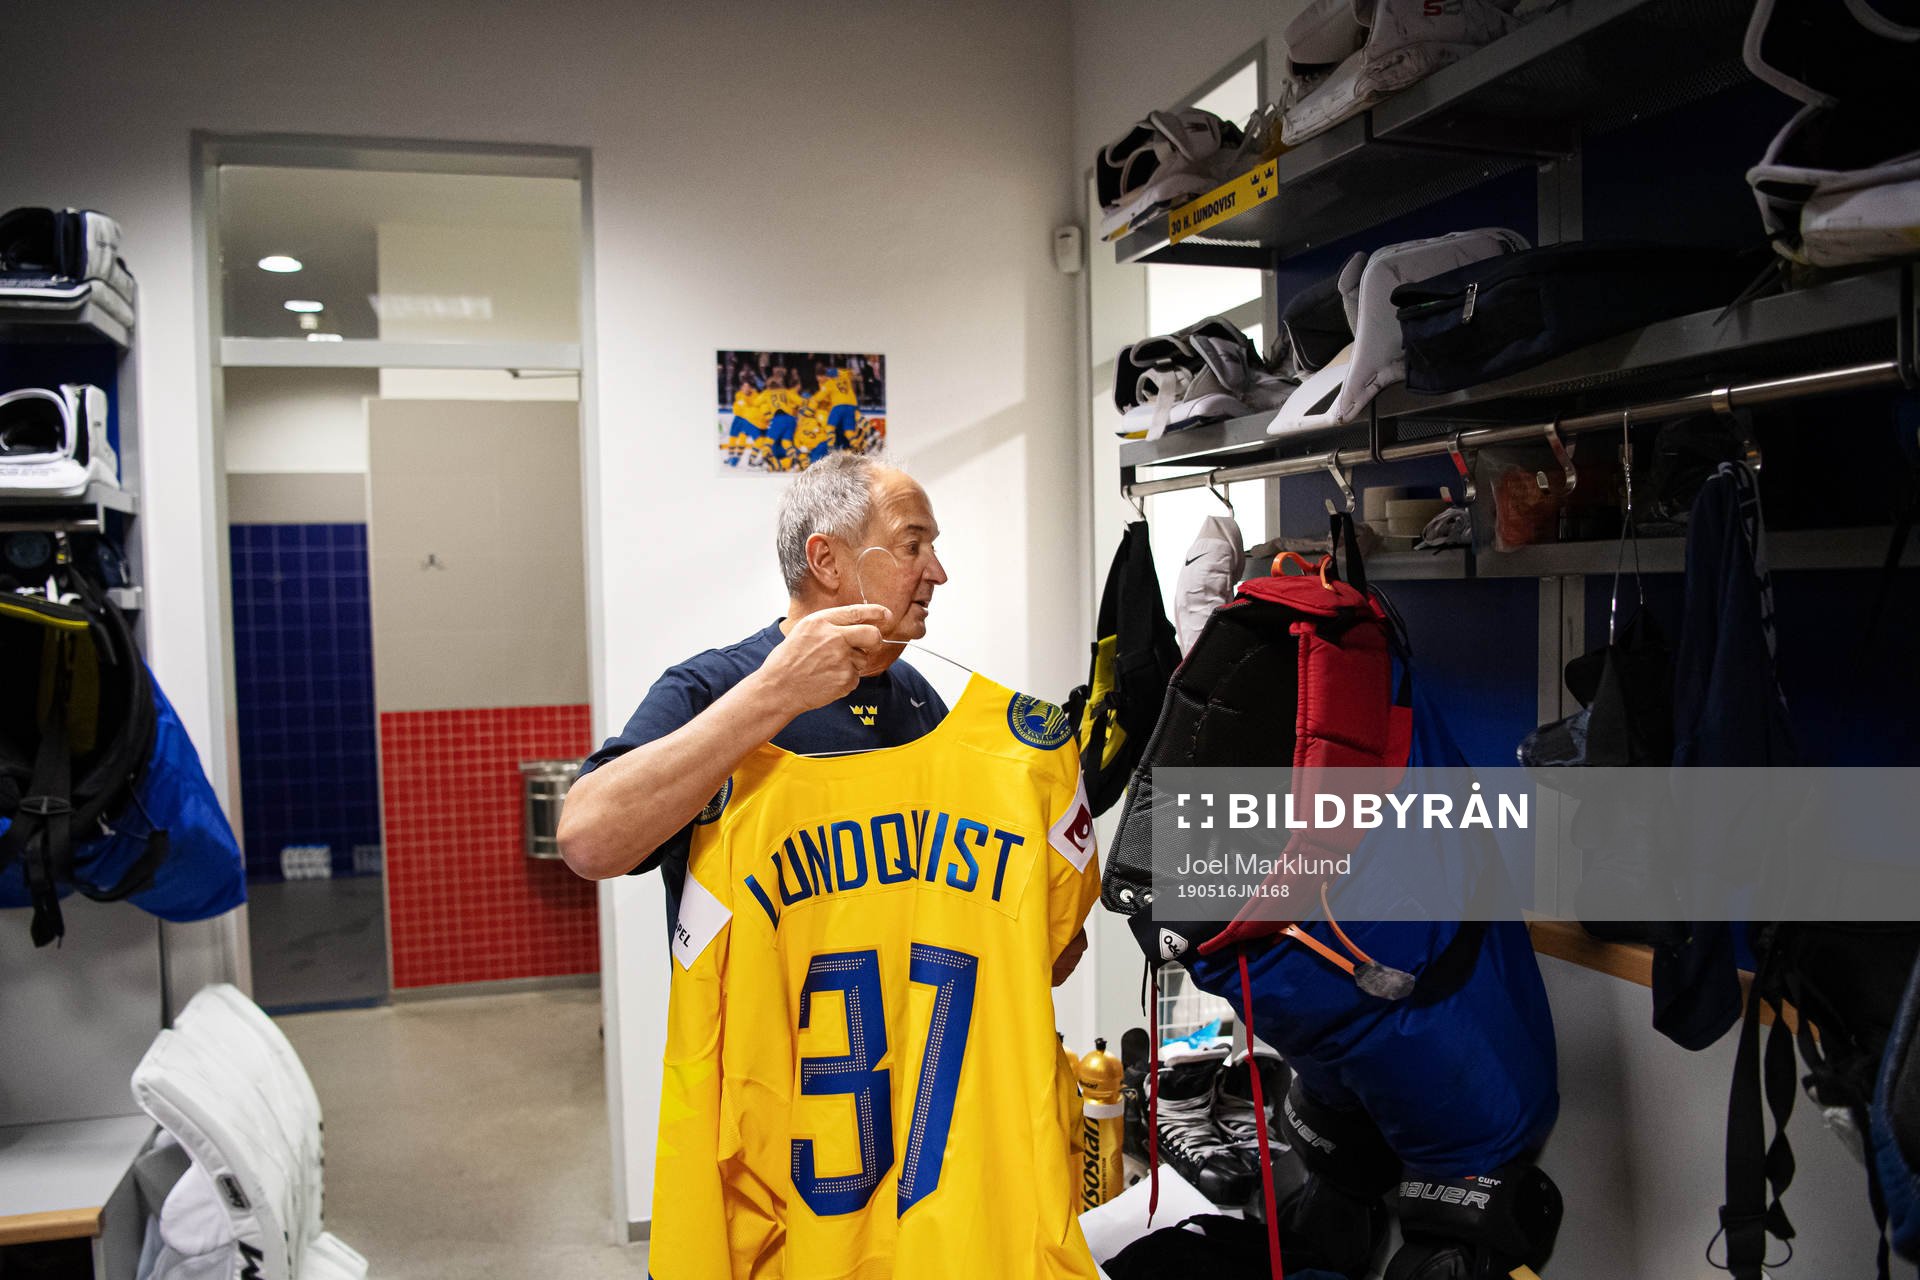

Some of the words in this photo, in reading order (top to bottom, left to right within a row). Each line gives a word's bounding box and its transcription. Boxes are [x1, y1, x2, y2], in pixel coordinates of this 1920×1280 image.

[1171, 219, 1181, 236] 30
[1183, 215, 1191, 230] H.
[1193, 191, 1236, 225] LUNDQVIST
[744, 810, 1025, 931] LUNDQVIST
[676, 917, 691, 948] PEL
[791, 942, 979, 1220] 37
